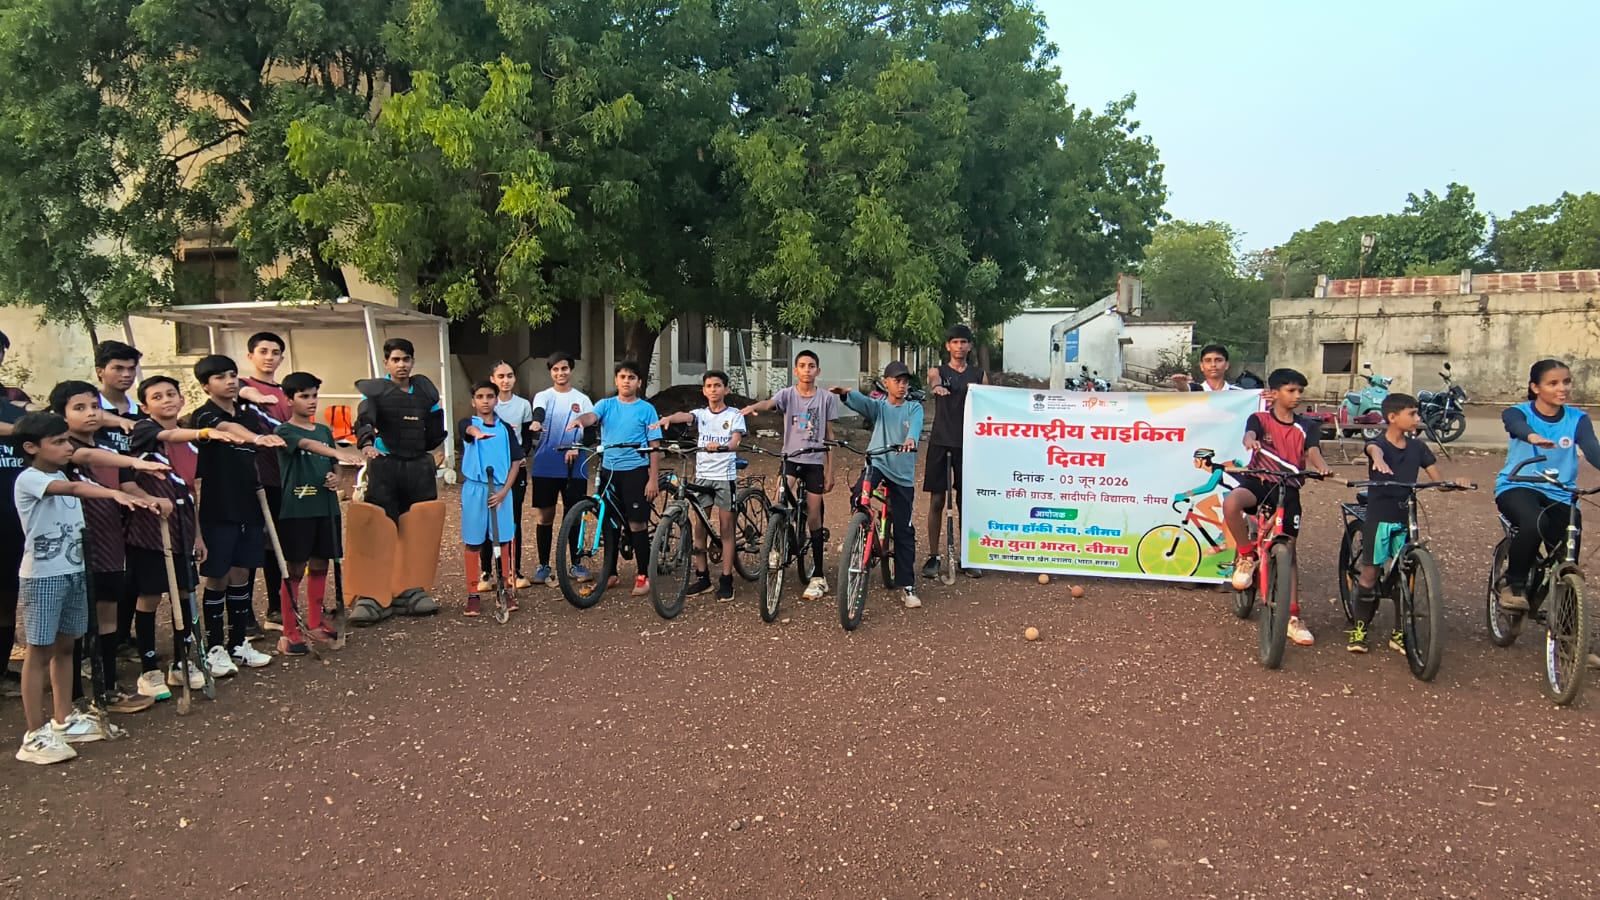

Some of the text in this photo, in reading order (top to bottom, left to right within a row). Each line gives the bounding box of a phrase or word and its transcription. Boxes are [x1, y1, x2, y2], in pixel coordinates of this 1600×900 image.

[975, 416, 1186, 443] अंतरराष्ट्रीय साइकिल
[1047, 445, 1106, 468] दिवस
[1013, 470, 1045, 483] दिनांक
[1059, 475, 1074, 485] 03
[1079, 476, 1096, 489] जून
[1099, 476, 1129, 487] 2026
[1005, 487, 1027, 499] हॉकी
[1143, 494, 1168, 505] नीमच
[987, 520, 1019, 531] जिला
[1022, 522, 1053, 533] हॉकी
[1084, 525, 1121, 537] नीमच
[980, 535, 1004, 548] मेरा
[1008, 540, 1036, 552] युवा
[1085, 542, 1129, 555] नीमच
